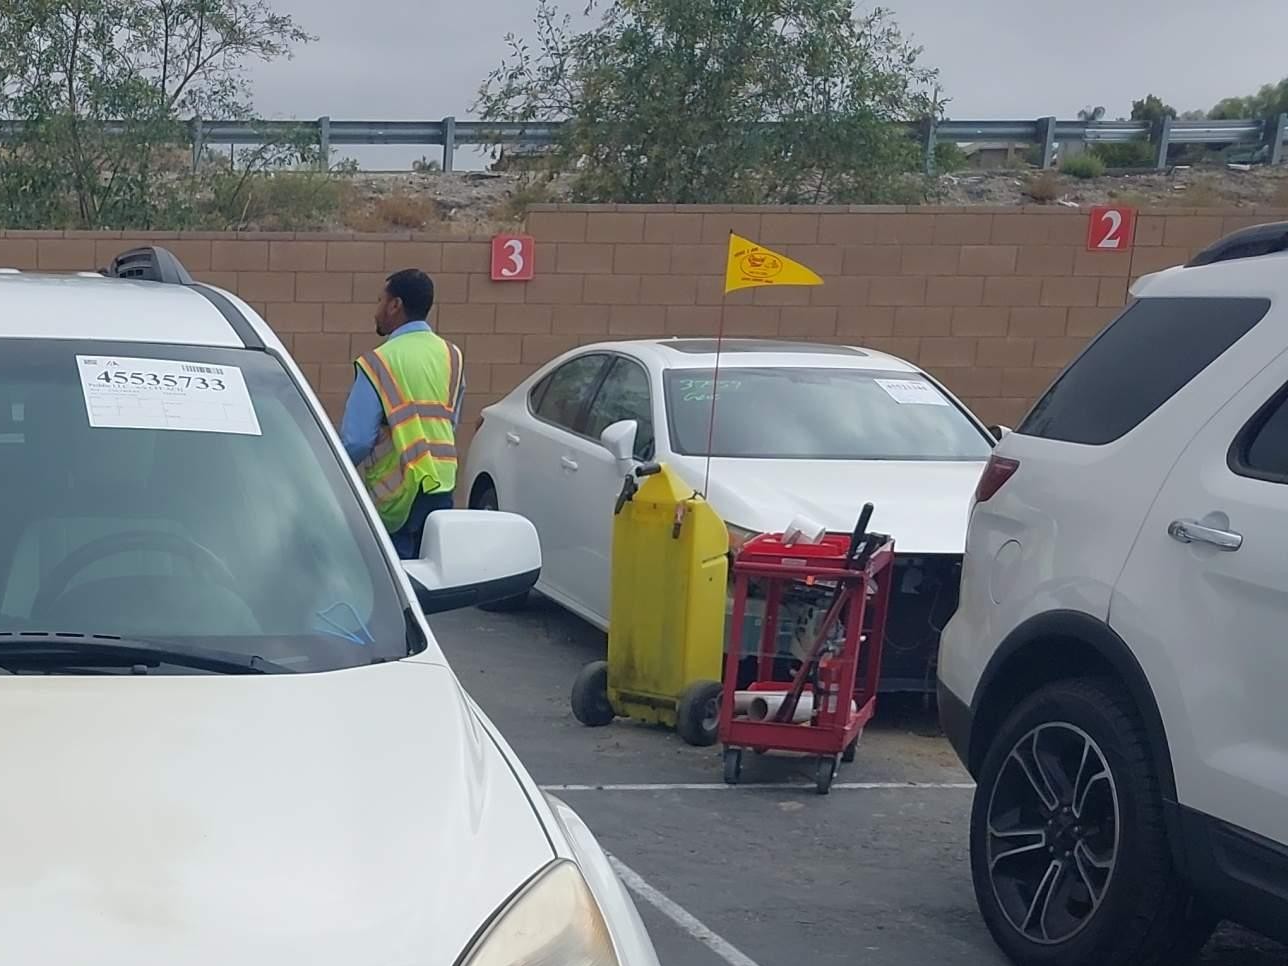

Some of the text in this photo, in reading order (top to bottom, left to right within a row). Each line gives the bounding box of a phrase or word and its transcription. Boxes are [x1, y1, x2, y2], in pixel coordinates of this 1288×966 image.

[1096, 210, 1122, 248] 2
[501, 239, 524, 276] 3
[96, 370, 226, 391] 45535733
